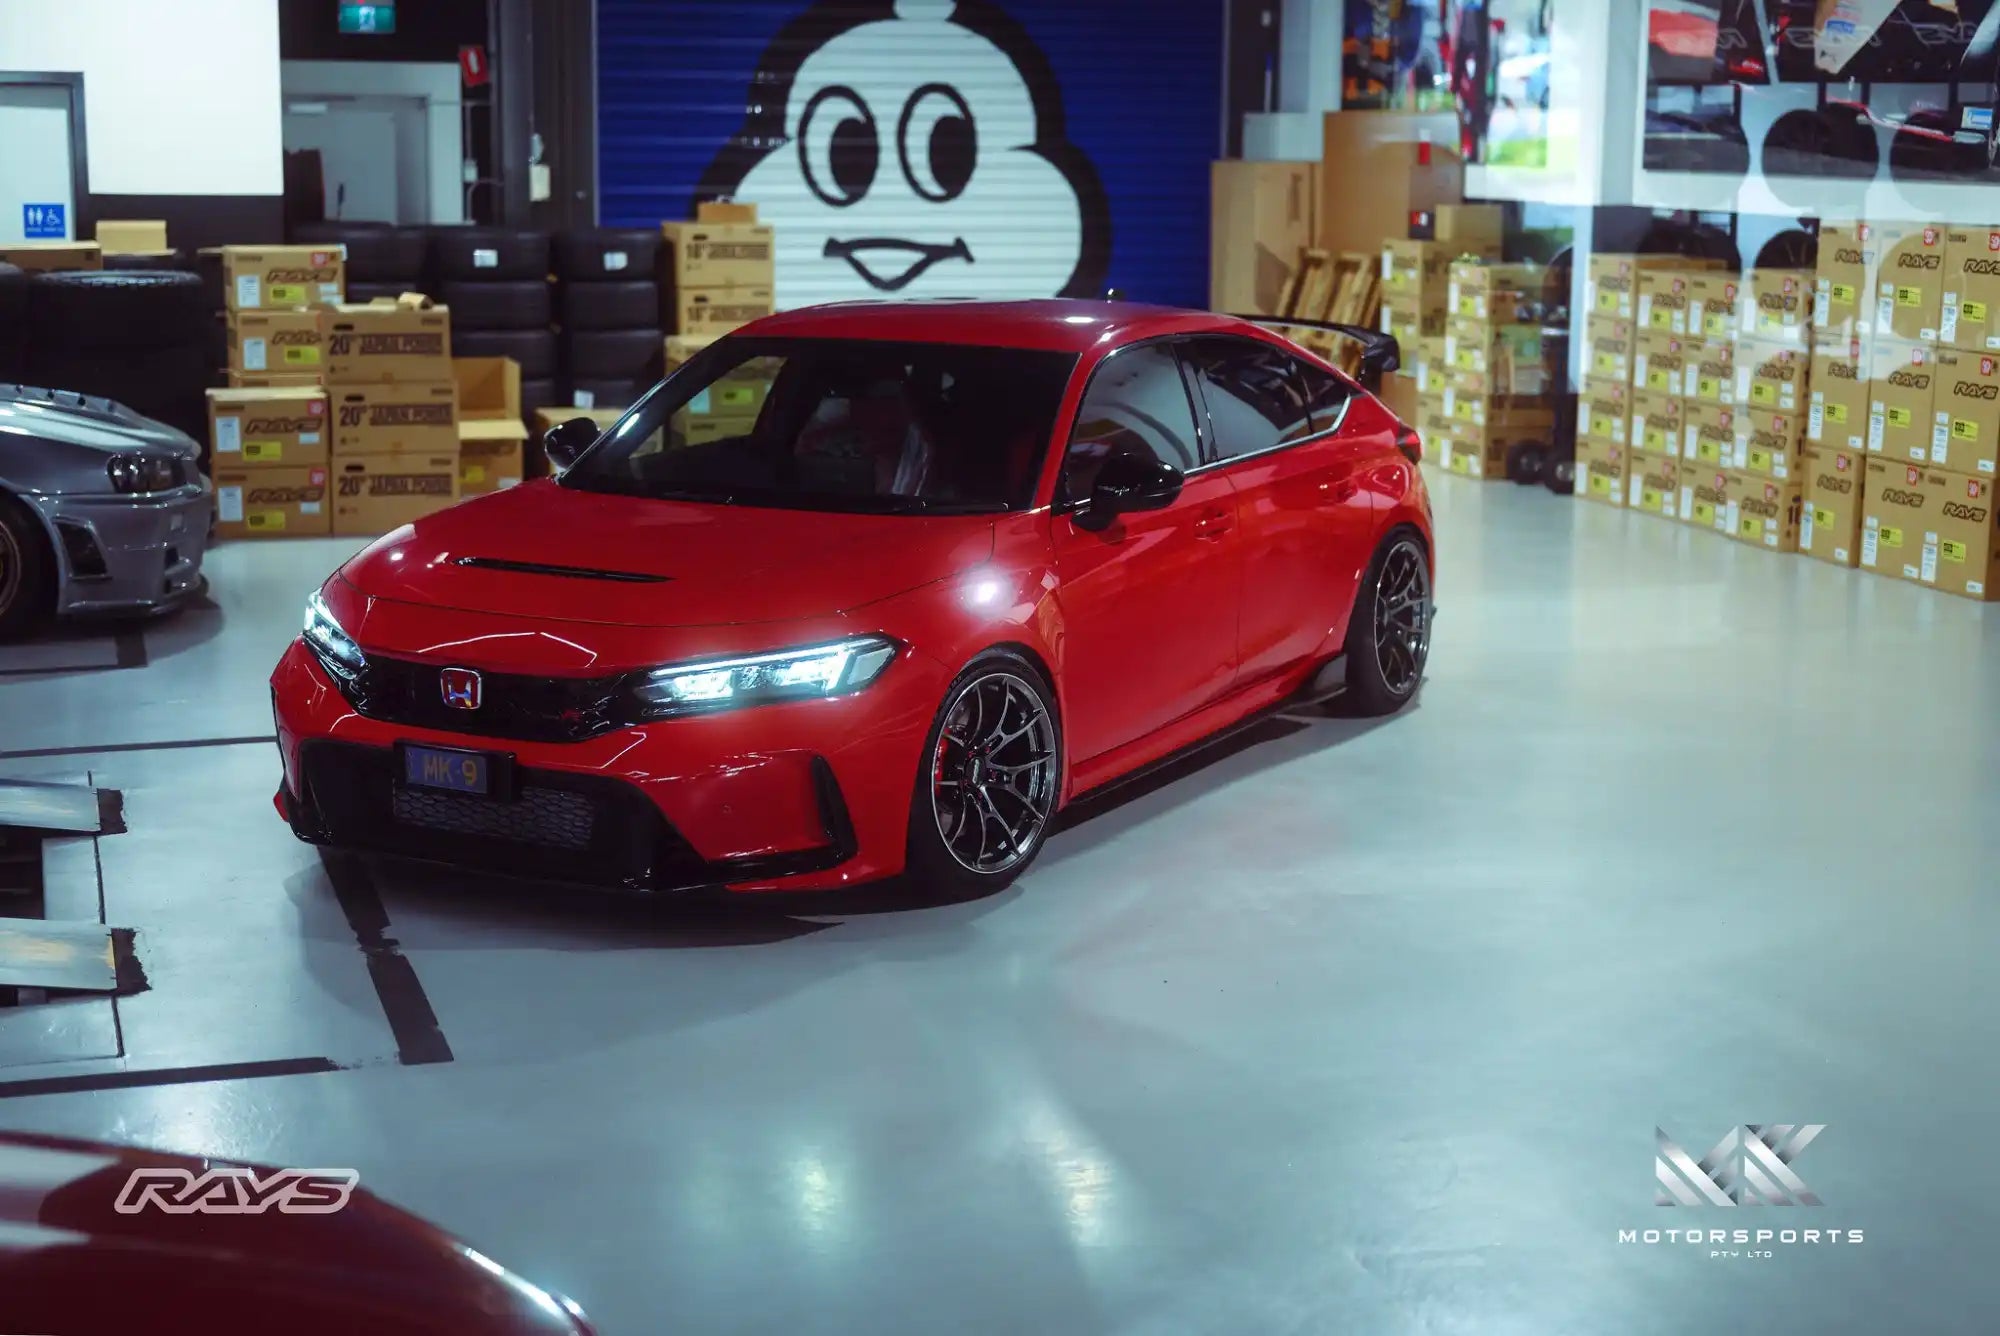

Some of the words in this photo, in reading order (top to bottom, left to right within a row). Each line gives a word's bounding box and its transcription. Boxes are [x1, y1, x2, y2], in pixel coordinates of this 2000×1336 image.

[1898, 252, 1940, 270] RAYS
[1888, 371, 1930, 390] RAYS
[1954, 381, 1998, 399] RAYS
[1882, 488, 1924, 508] RAYS
[1942, 501, 1987, 522] RAYS
[423, 753, 453, 784] MK
[461, 759, 477, 787] 9
